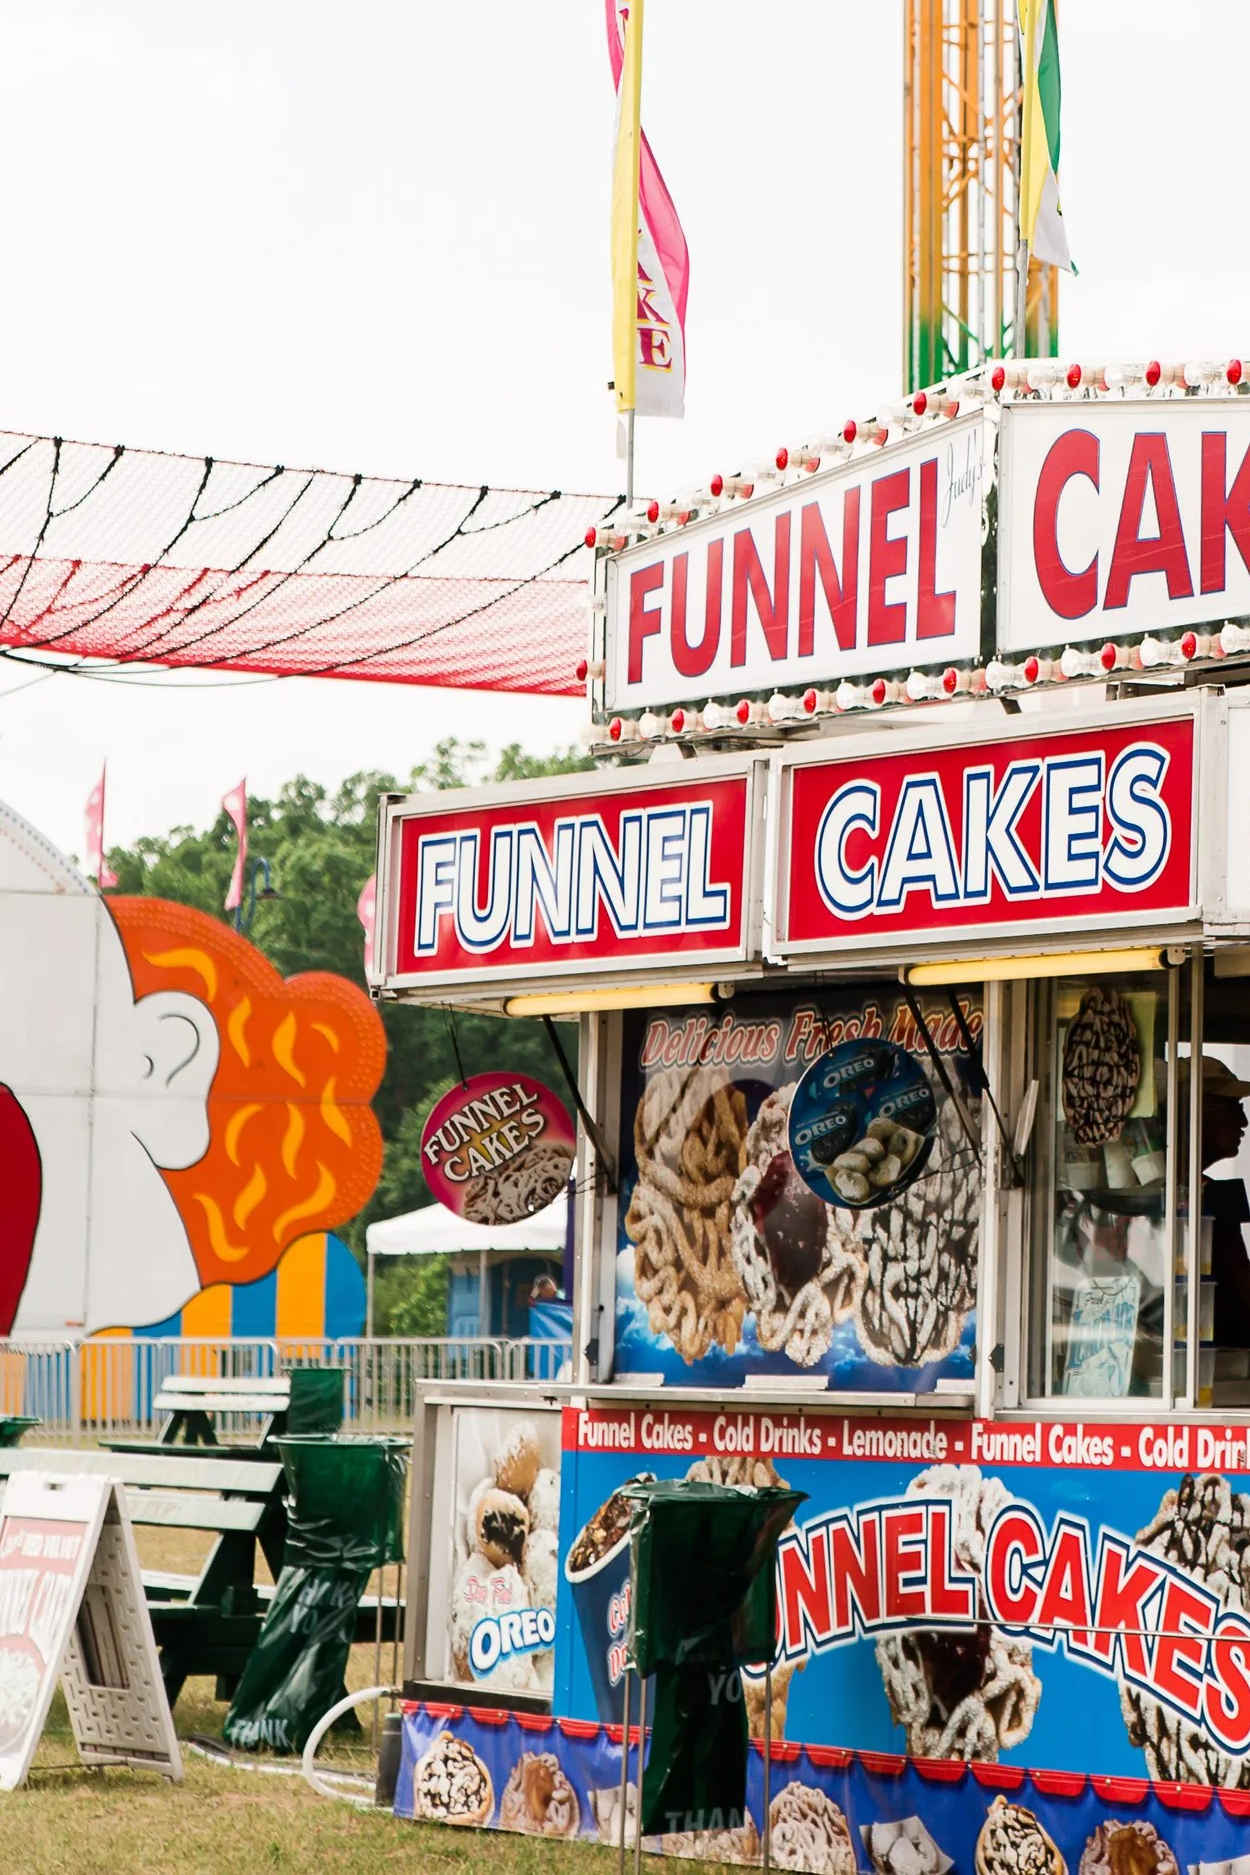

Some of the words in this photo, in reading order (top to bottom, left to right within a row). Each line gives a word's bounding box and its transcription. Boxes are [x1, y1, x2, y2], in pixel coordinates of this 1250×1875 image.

[626, 456, 959, 685] FUNNEL
[814, 742, 1172, 922] CAKES
[413, 800, 732, 958] FUNNEL
[641, 1014, 780, 1067] Delicious
[785, 1005, 883, 1062] Fresh
[886, 1003, 985, 1053] Made
[823, 1057, 875, 1089] OREO
[879, 1088, 930, 1119] OREO
[424, 1083, 538, 1165] FUNNEL
[444, 1108, 545, 1182] CAKES
[795, 1116, 846, 1145] OREO
[578, 1412, 635, 1448] Funnel
[641, 1413, 693, 1450] Cakes
[713, 1415, 754, 1452] Cold
[760, 1417, 822, 1455] Drinks
[842, 1420, 947, 1459] Lemonade
[971, 1421, 1041, 1463] Funnel
[1048, 1424, 1114, 1466] Cakes
[1138, 1425, 1189, 1468] Cold
[774, 1501, 976, 1663] NNEL
[470, 1609, 555, 1676] OREO
[707, 1672, 742, 1706] YO
[664, 1807, 745, 1834] THAN
